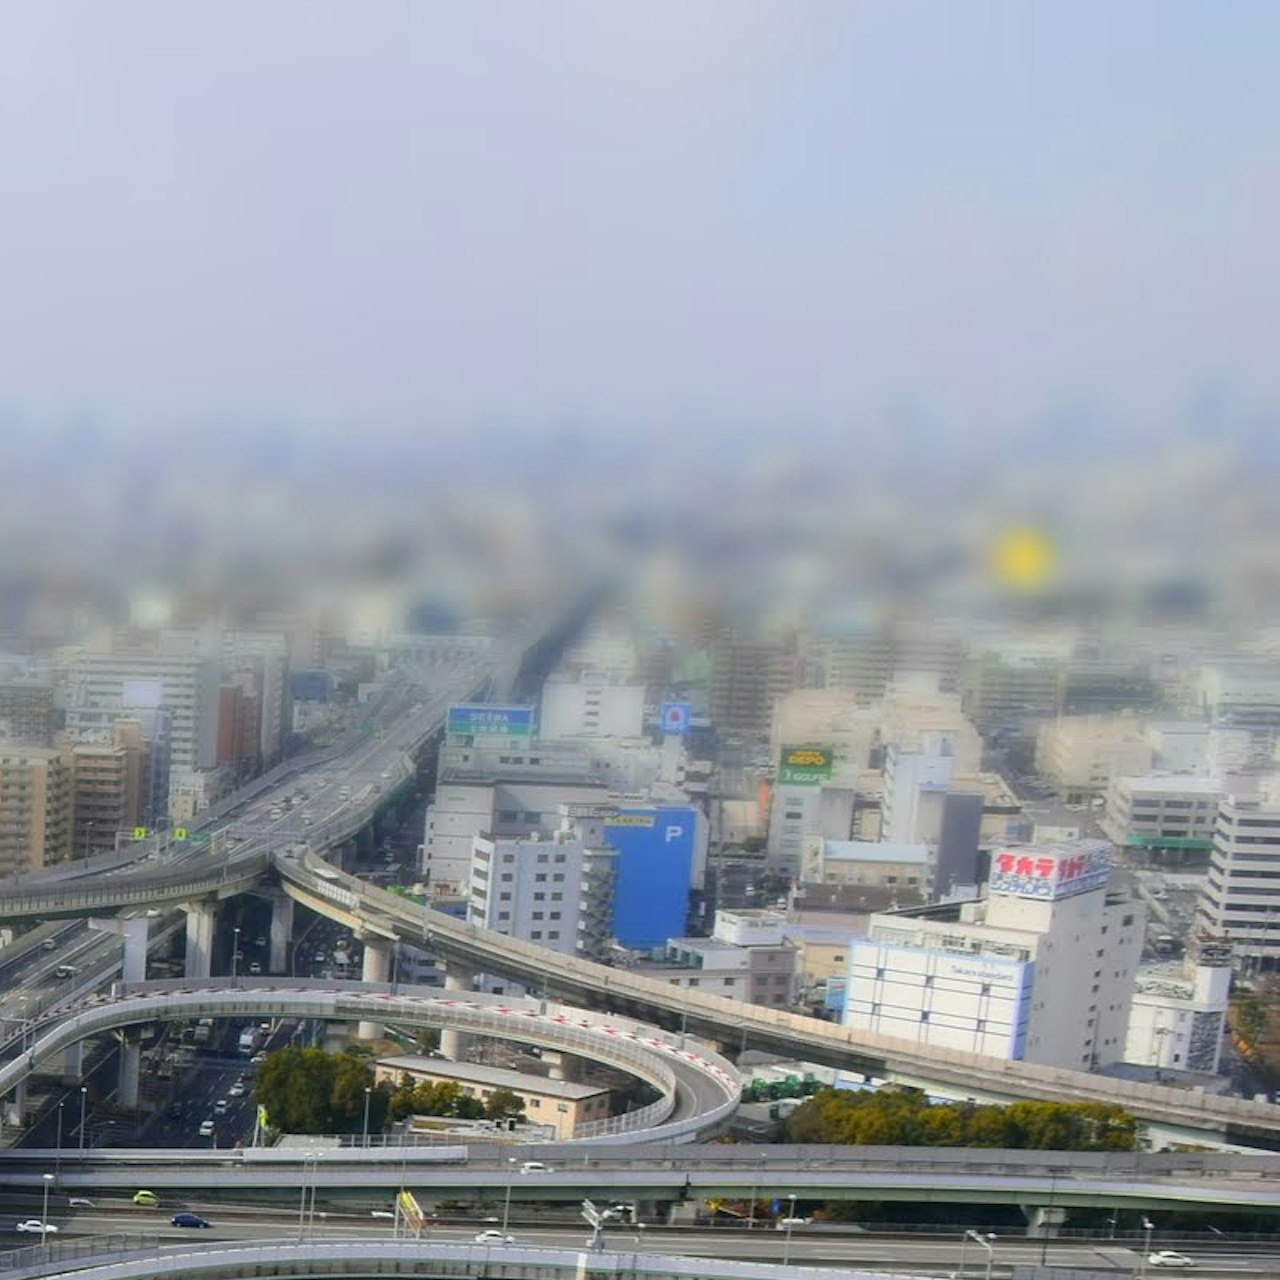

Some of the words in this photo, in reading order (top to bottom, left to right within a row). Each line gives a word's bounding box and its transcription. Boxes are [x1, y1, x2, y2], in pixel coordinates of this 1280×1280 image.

[665, 825, 683, 842] P
[996, 853, 1054, 877] タカラ
